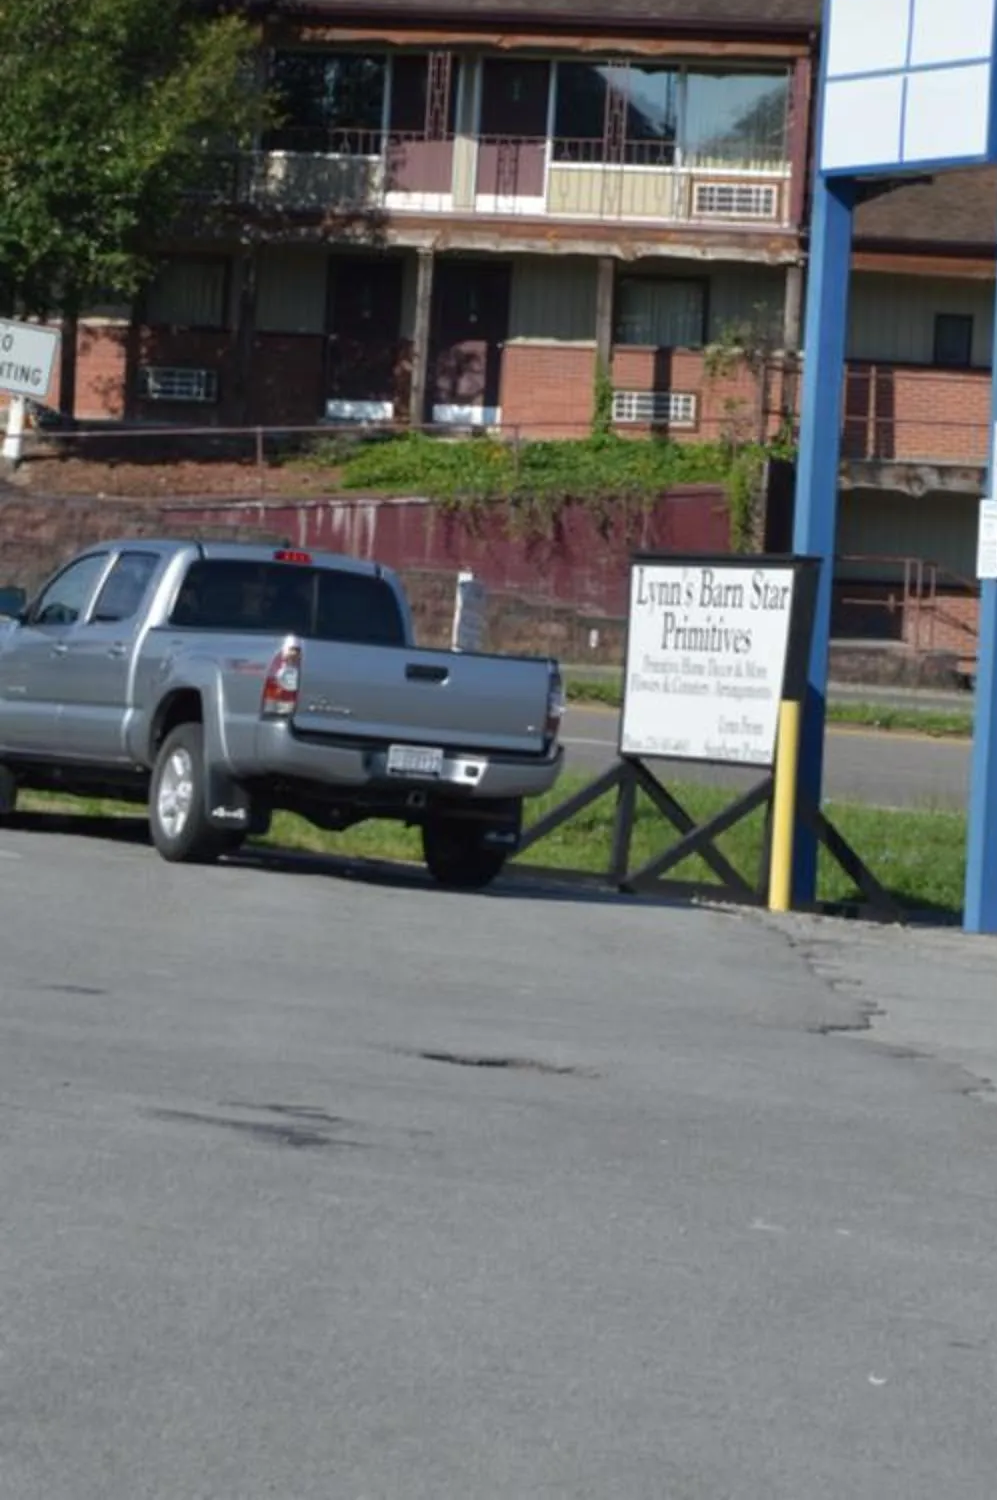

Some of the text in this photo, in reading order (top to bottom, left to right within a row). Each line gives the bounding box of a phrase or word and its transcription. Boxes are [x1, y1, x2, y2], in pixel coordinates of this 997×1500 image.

[0, 361, 43, 387] TING
[635, 567, 790, 613] Lynn's Barn Star
[660, 611, 753, 654] Primitives
